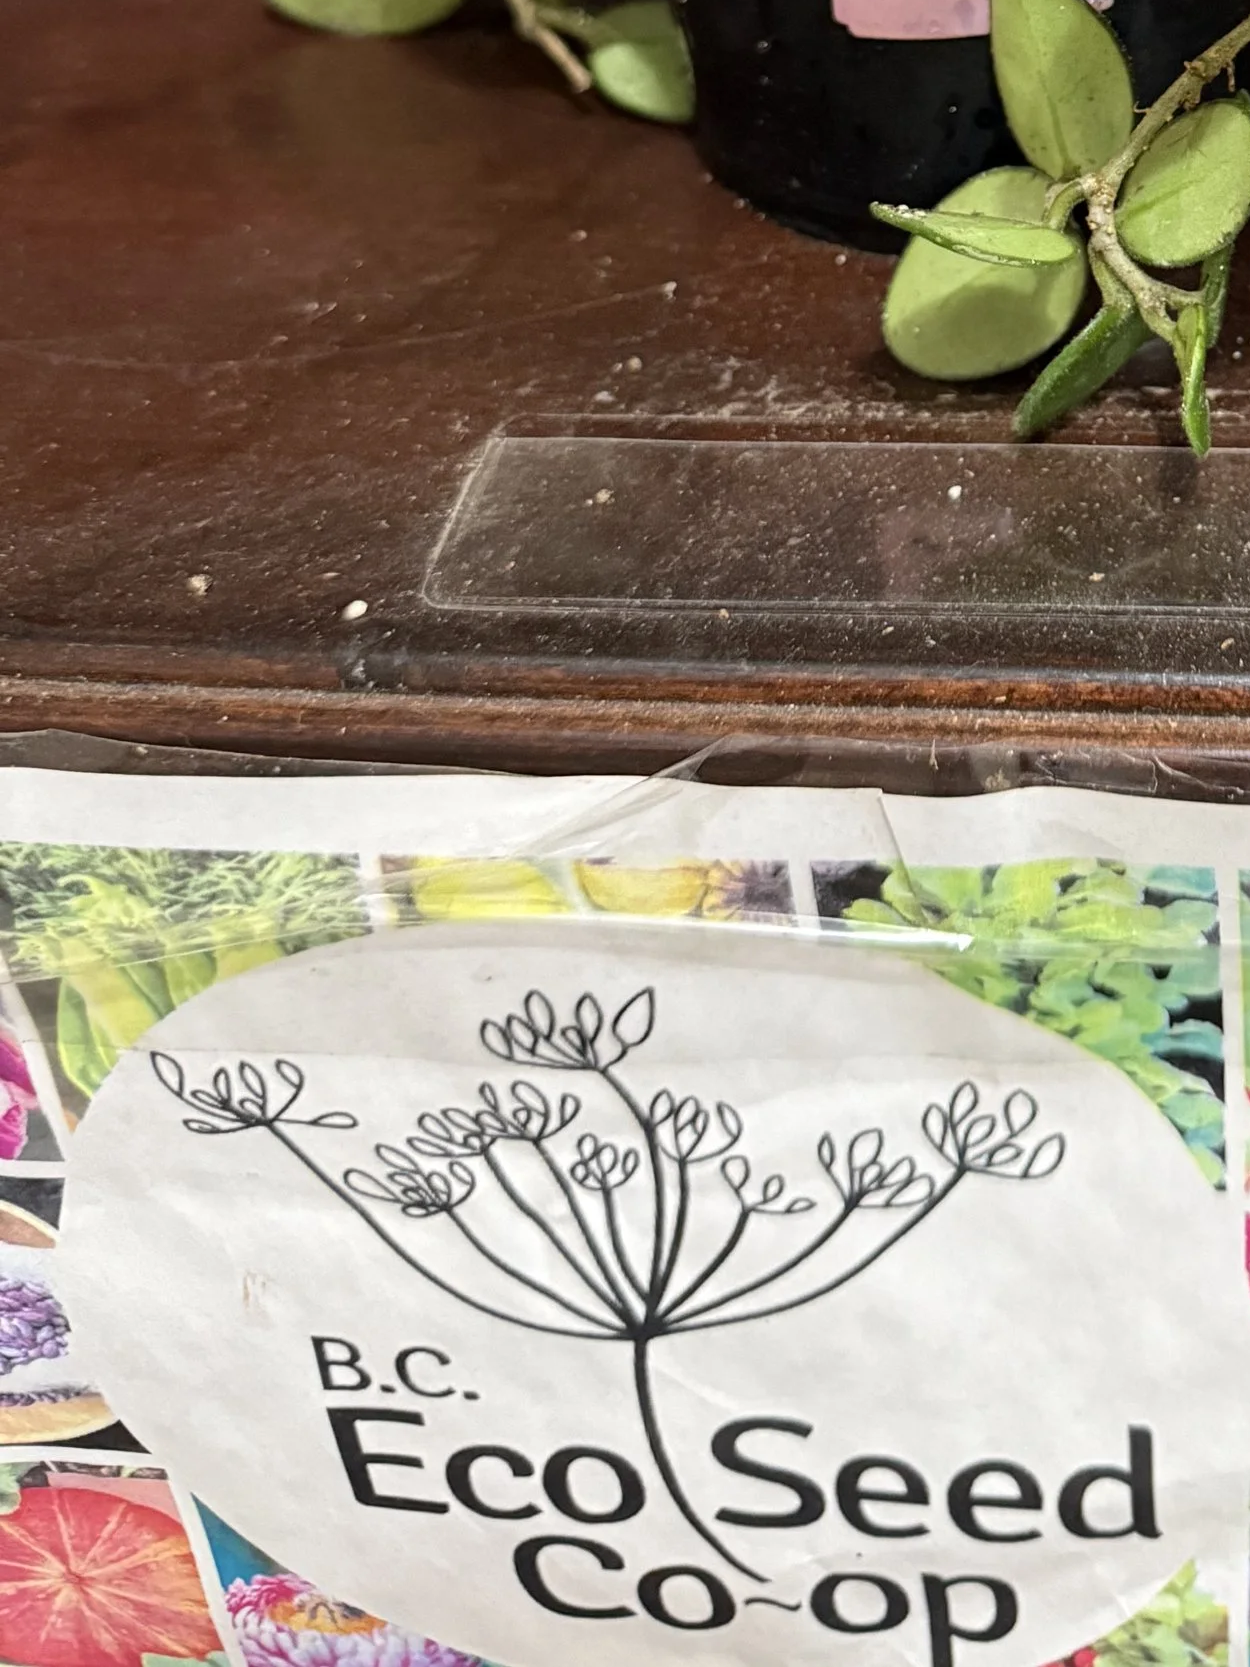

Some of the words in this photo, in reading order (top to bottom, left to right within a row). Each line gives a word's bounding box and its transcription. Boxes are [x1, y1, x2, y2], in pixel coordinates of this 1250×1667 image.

[311, 1336, 480, 1400] B.C.
[326, 1407, 647, 1524] Eco
[710, 1415, 1163, 1543] Seed
